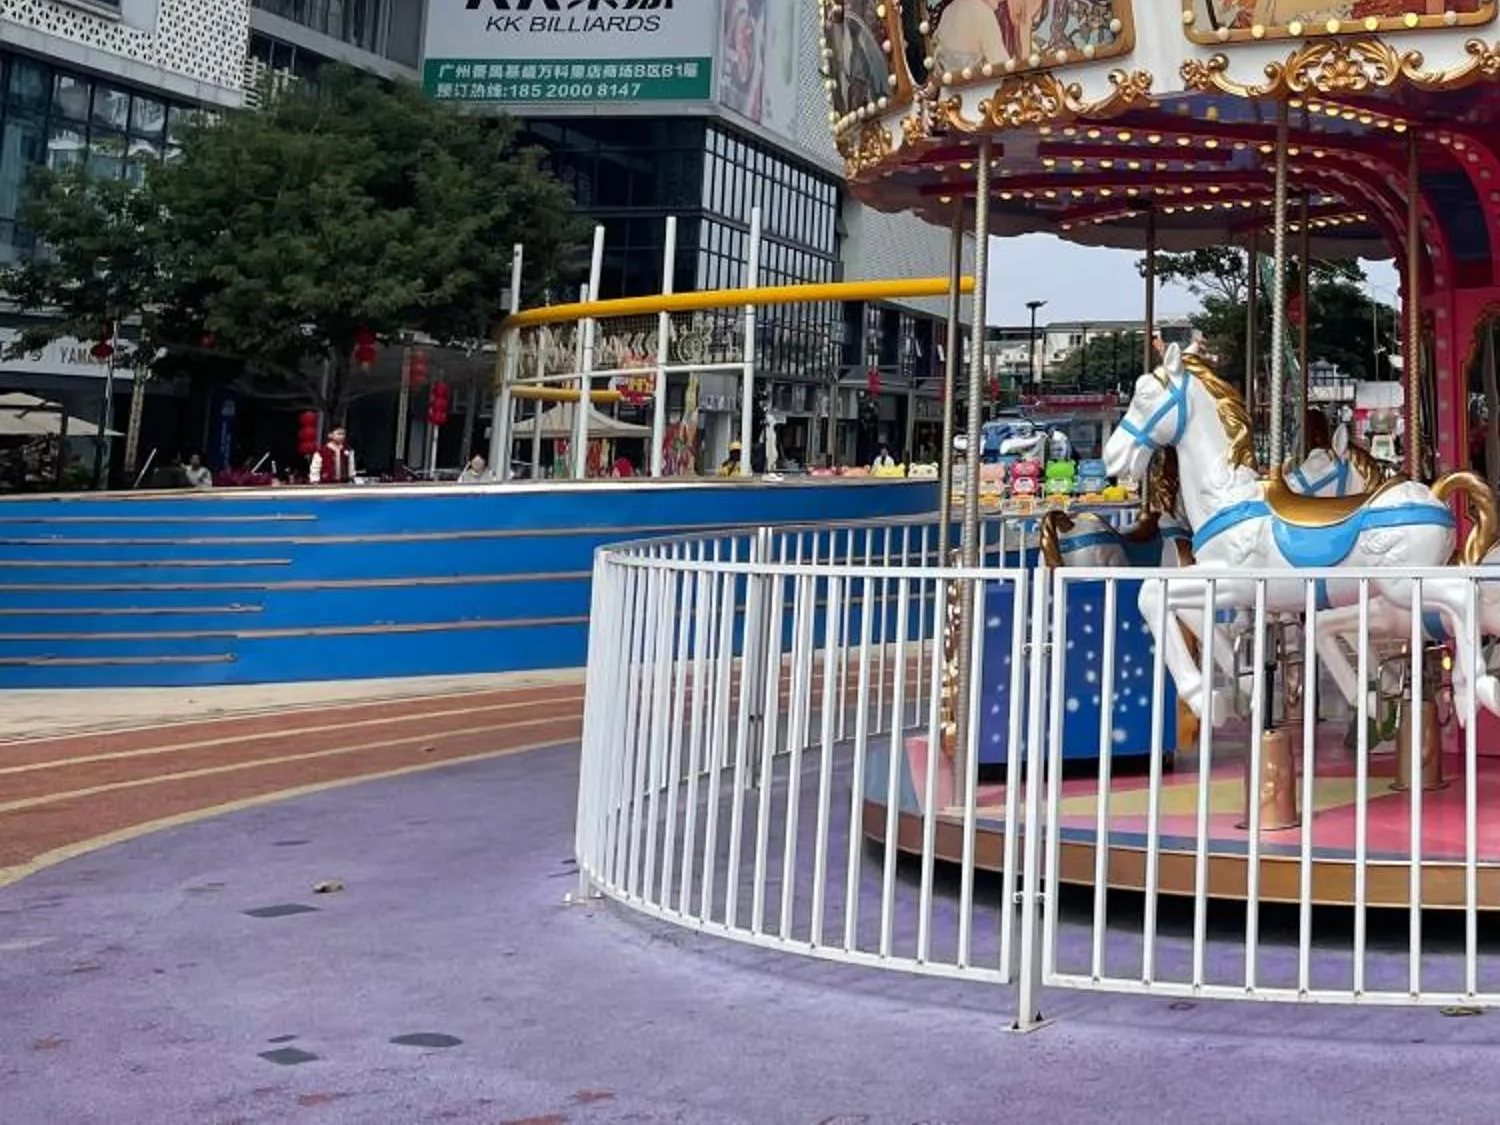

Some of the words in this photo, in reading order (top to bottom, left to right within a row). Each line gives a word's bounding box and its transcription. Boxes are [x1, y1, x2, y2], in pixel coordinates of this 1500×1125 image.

[485, 16, 525, 32] KK
[529, 15, 661, 32] BILLIARDS
[546, 83, 593, 98] 2000
[597, 83, 642, 98] 8147
